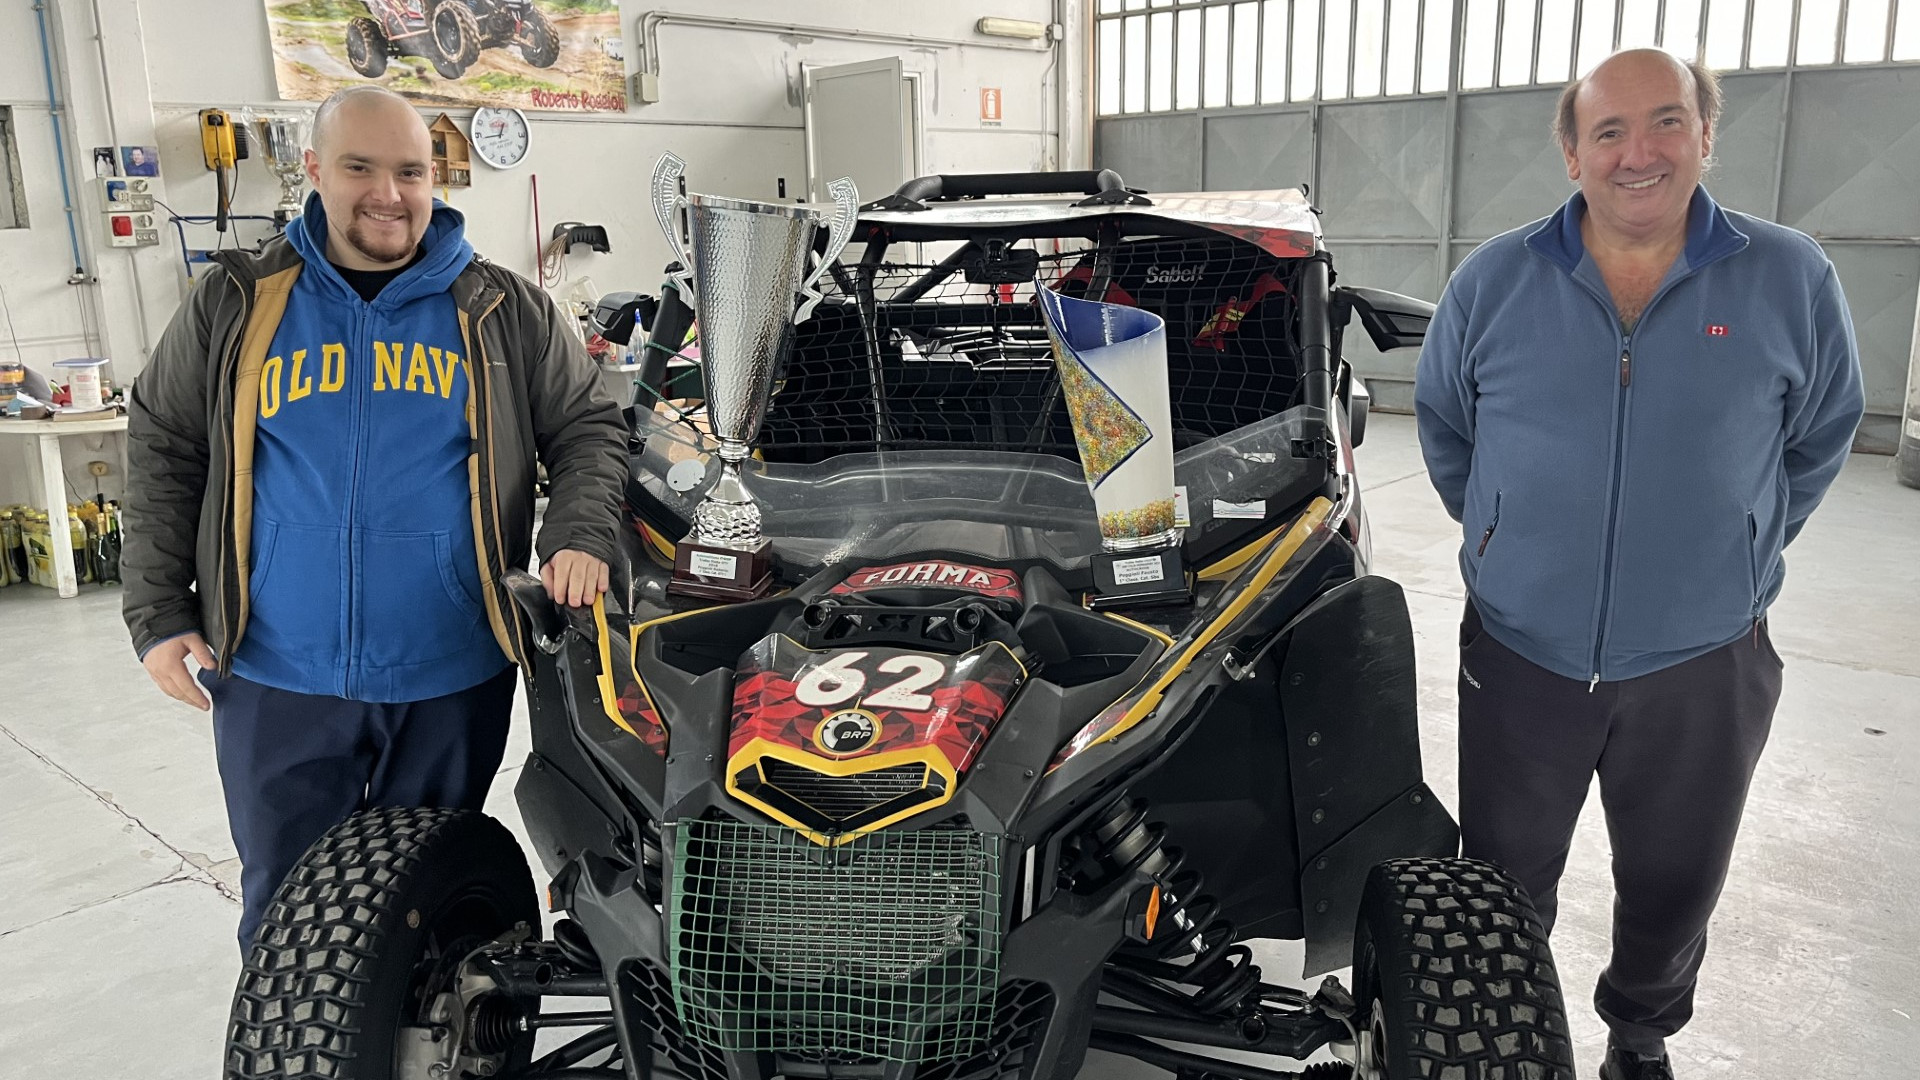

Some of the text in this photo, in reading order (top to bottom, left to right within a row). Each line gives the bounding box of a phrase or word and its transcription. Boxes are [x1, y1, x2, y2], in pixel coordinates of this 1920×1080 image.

[531, 87, 578, 109] Roberto
[1146, 264, 1205, 284] Sabelt
[259, 342, 345, 419] OLD
[863, 563, 991, 585] FORMA
[795, 652, 946, 711] 62
[841, 731, 871, 739] BRP
